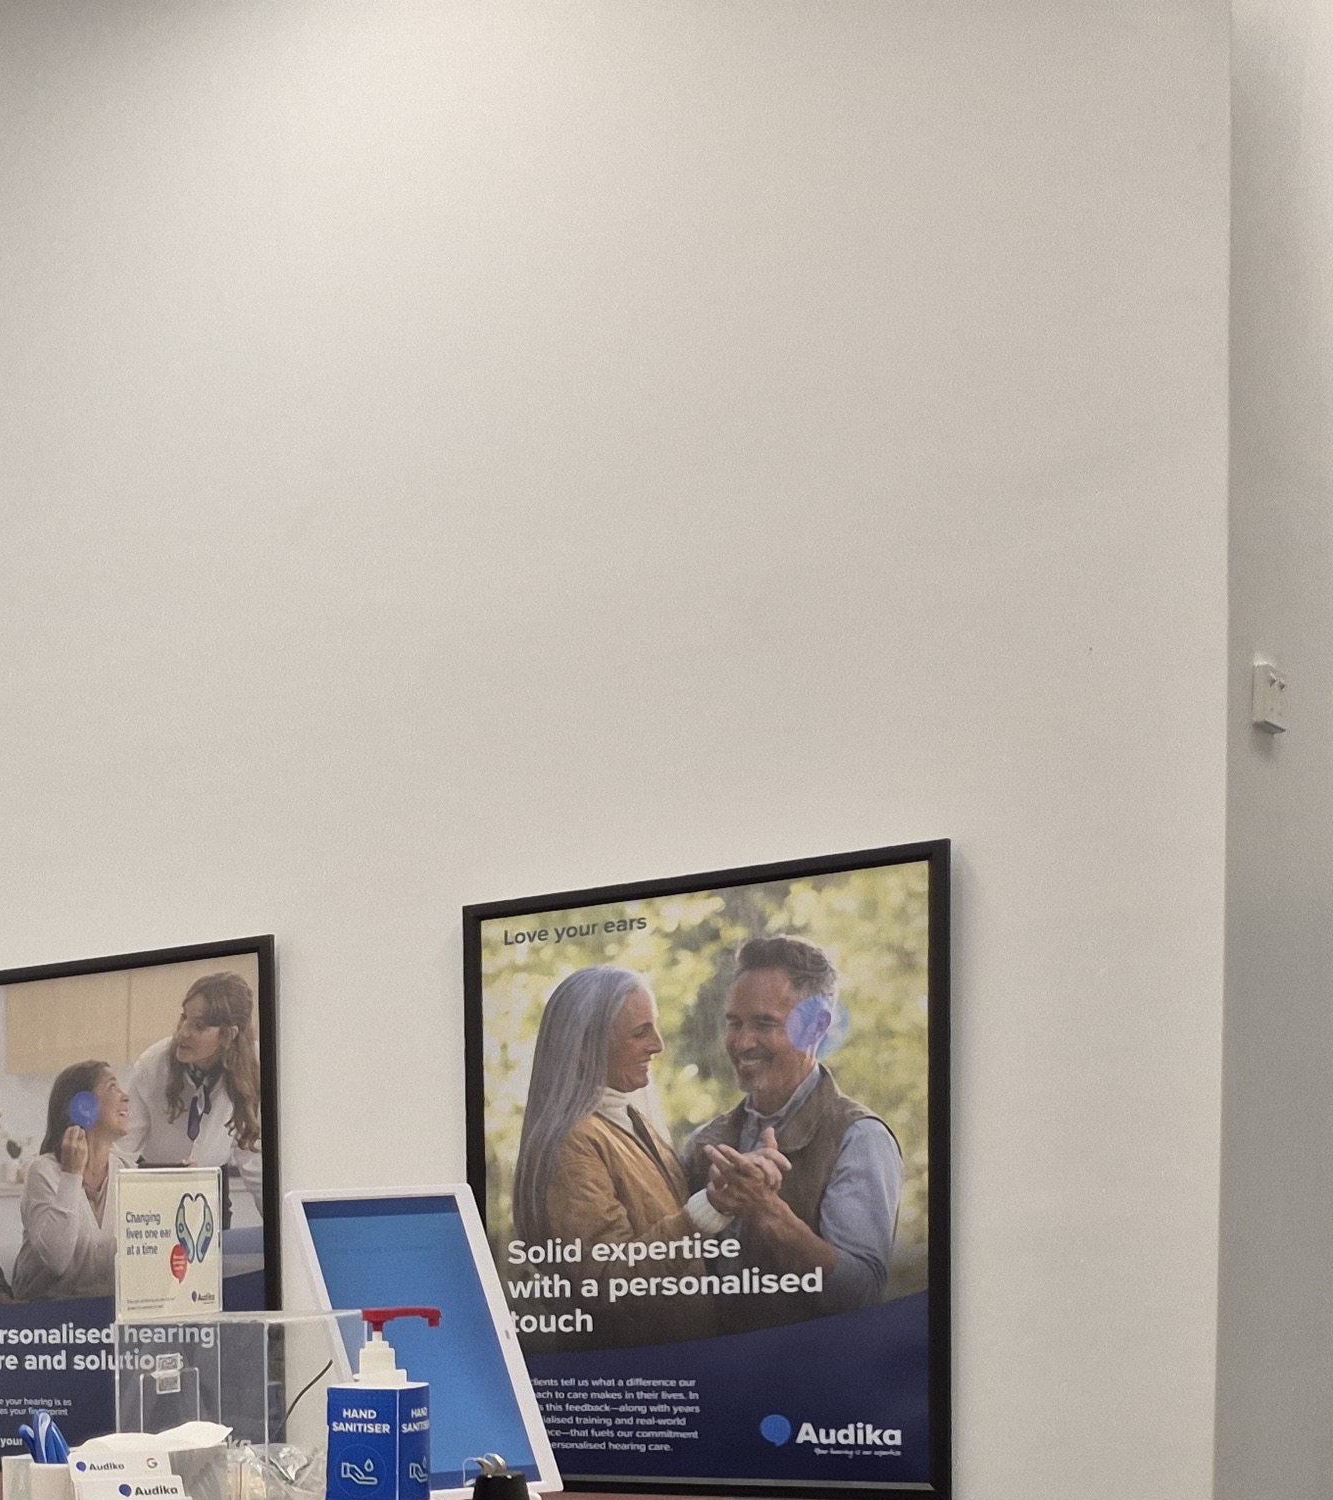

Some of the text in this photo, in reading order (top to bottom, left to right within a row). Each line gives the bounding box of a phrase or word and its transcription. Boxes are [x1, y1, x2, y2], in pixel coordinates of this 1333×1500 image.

[504, 917, 647, 946] Love your ears
[125, 1210, 161, 1226] Changing
[126, 1228, 172, 1239] lives one ear
[126, 1245, 135, 1255] at
[142, 1243, 158, 1254] time
[507, 1232, 741, 1267] Solid expertise
[508, 1266, 824, 1303] with a personalised
[511, 1308, 594, 1333] touch
[124, 1323, 215, 1349] hearing
[24, 1350, 67, 1371] and
[73, 1349, 184, 1371] solutio
[531, 1378, 559, 1387] lients
[561, 1378, 575, 1387] tell
[591, 1378, 615, 1387] what
[626, 1378, 677, 1387] difference
[555, 1391, 565, 1399] to
[567, 1392, 588, 1400] care
[591, 1391, 622, 1400] makes
[625, 1391, 634, 1399] in
[635, 1391, 658, 1400] their
[689, 1391, 699, 1400] In
[5, 1398, 22, 1406] your
[23, 1397, 53, 1407] hearing
[54, 1397, 61, 1406] is
[9, 1408, 26, 1416] your
[343, 1408, 377, 1419] HAND
[546, 1403, 562, 1412] this
[649, 1404, 670, 1413] with
[672, 1406, 701, 1414] years
[575, 1416, 613, 1426] training
[614, 1417, 633, 1425] and
[332, 1422, 391, 1434] SANITISER
[590, 1429, 615, 1438] fuels
[635, 1430, 699, 1439] commitment
[796, 1422, 902, 1446] Audika
[551, 1441, 673, 1452] ersonalised hearing care.
[89, 1462, 125, 1471] Audika
[135, 1485, 178, 1496] Audika
